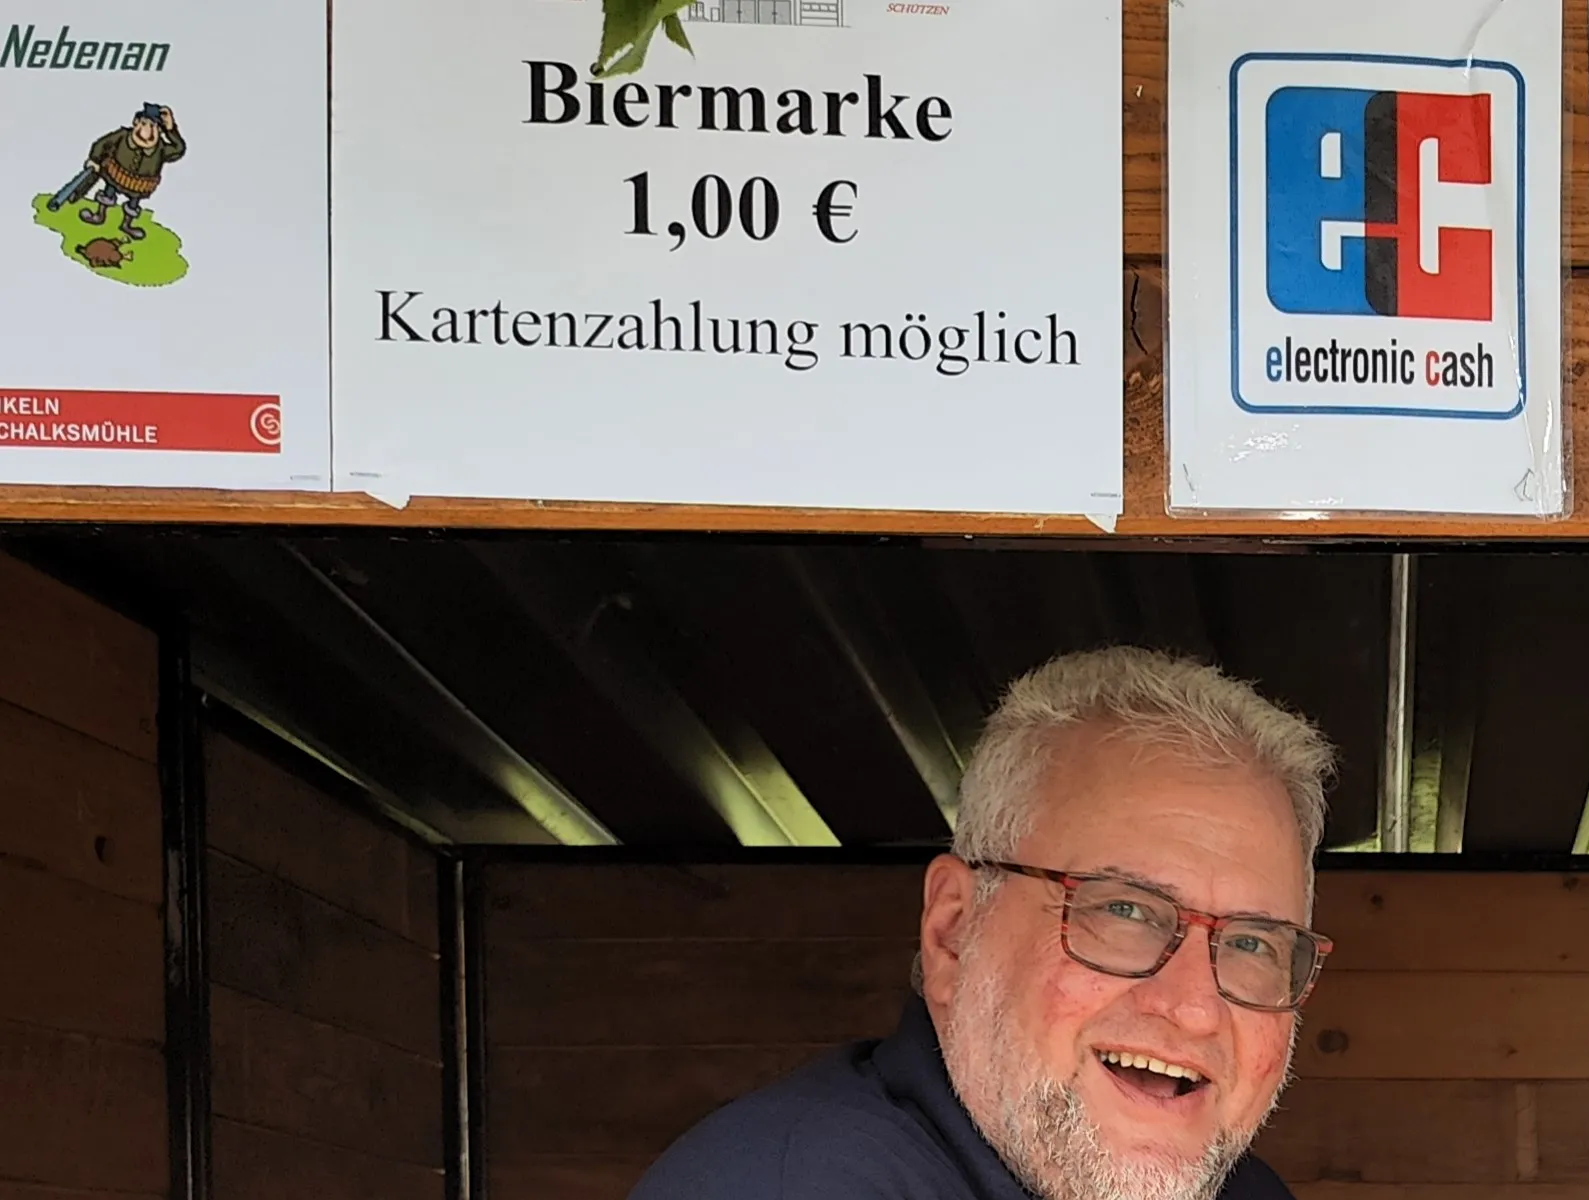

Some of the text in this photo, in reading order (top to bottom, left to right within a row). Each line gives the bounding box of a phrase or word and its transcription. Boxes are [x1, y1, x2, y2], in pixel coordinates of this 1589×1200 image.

[0, 24, 170, 71] Nebenan
[522, 59, 953, 142] Biermarke
[624, 170, 861, 252] 1,00 €
[375, 290, 1081, 376] Kartenzahlung möglich
[1266, 336, 1494, 389] electronic cash
[0, 397, 59, 416] KELN
